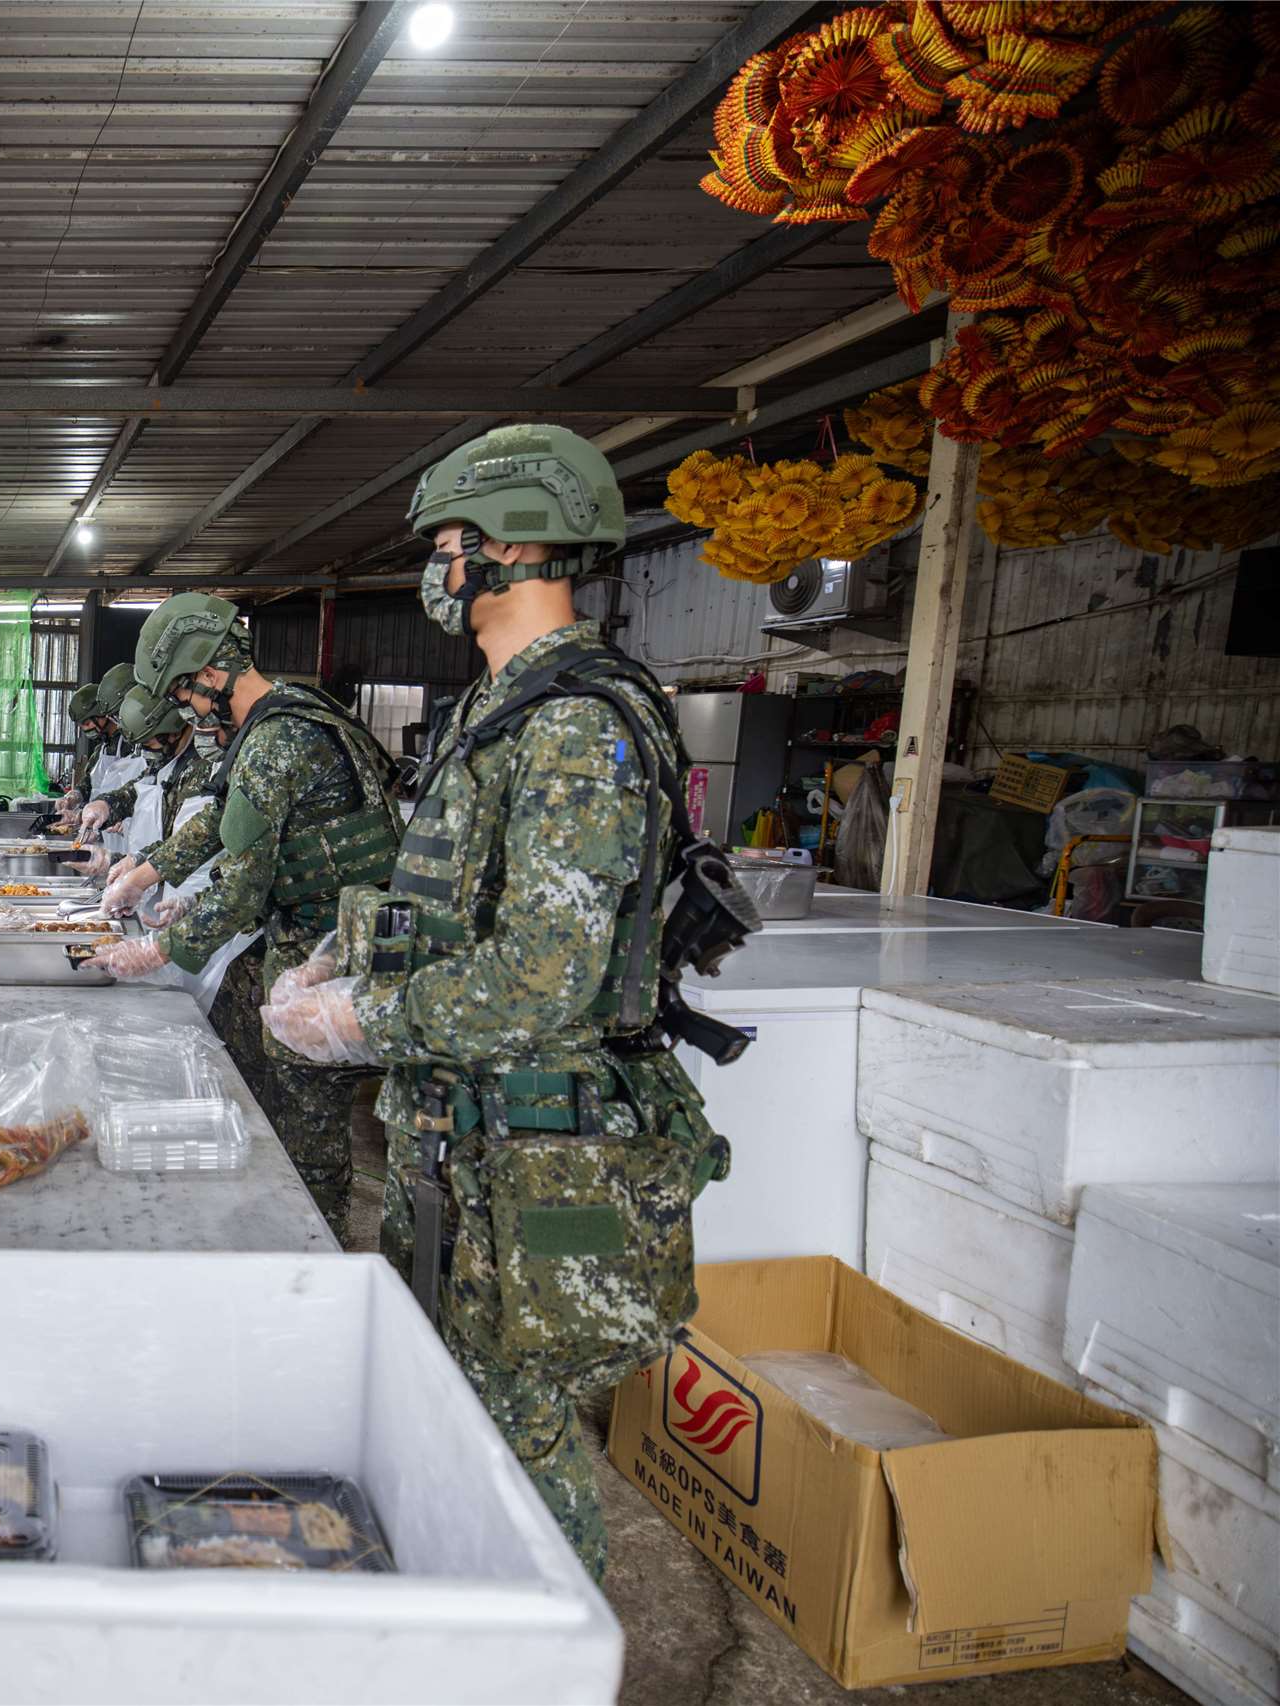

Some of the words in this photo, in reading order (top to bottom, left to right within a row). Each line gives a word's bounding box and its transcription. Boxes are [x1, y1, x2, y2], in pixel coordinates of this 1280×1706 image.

[634, 1458, 682, 1519] MADE
[688, 1508, 706, 1540] IN
[712, 1530, 797, 1625] TAIWAN
